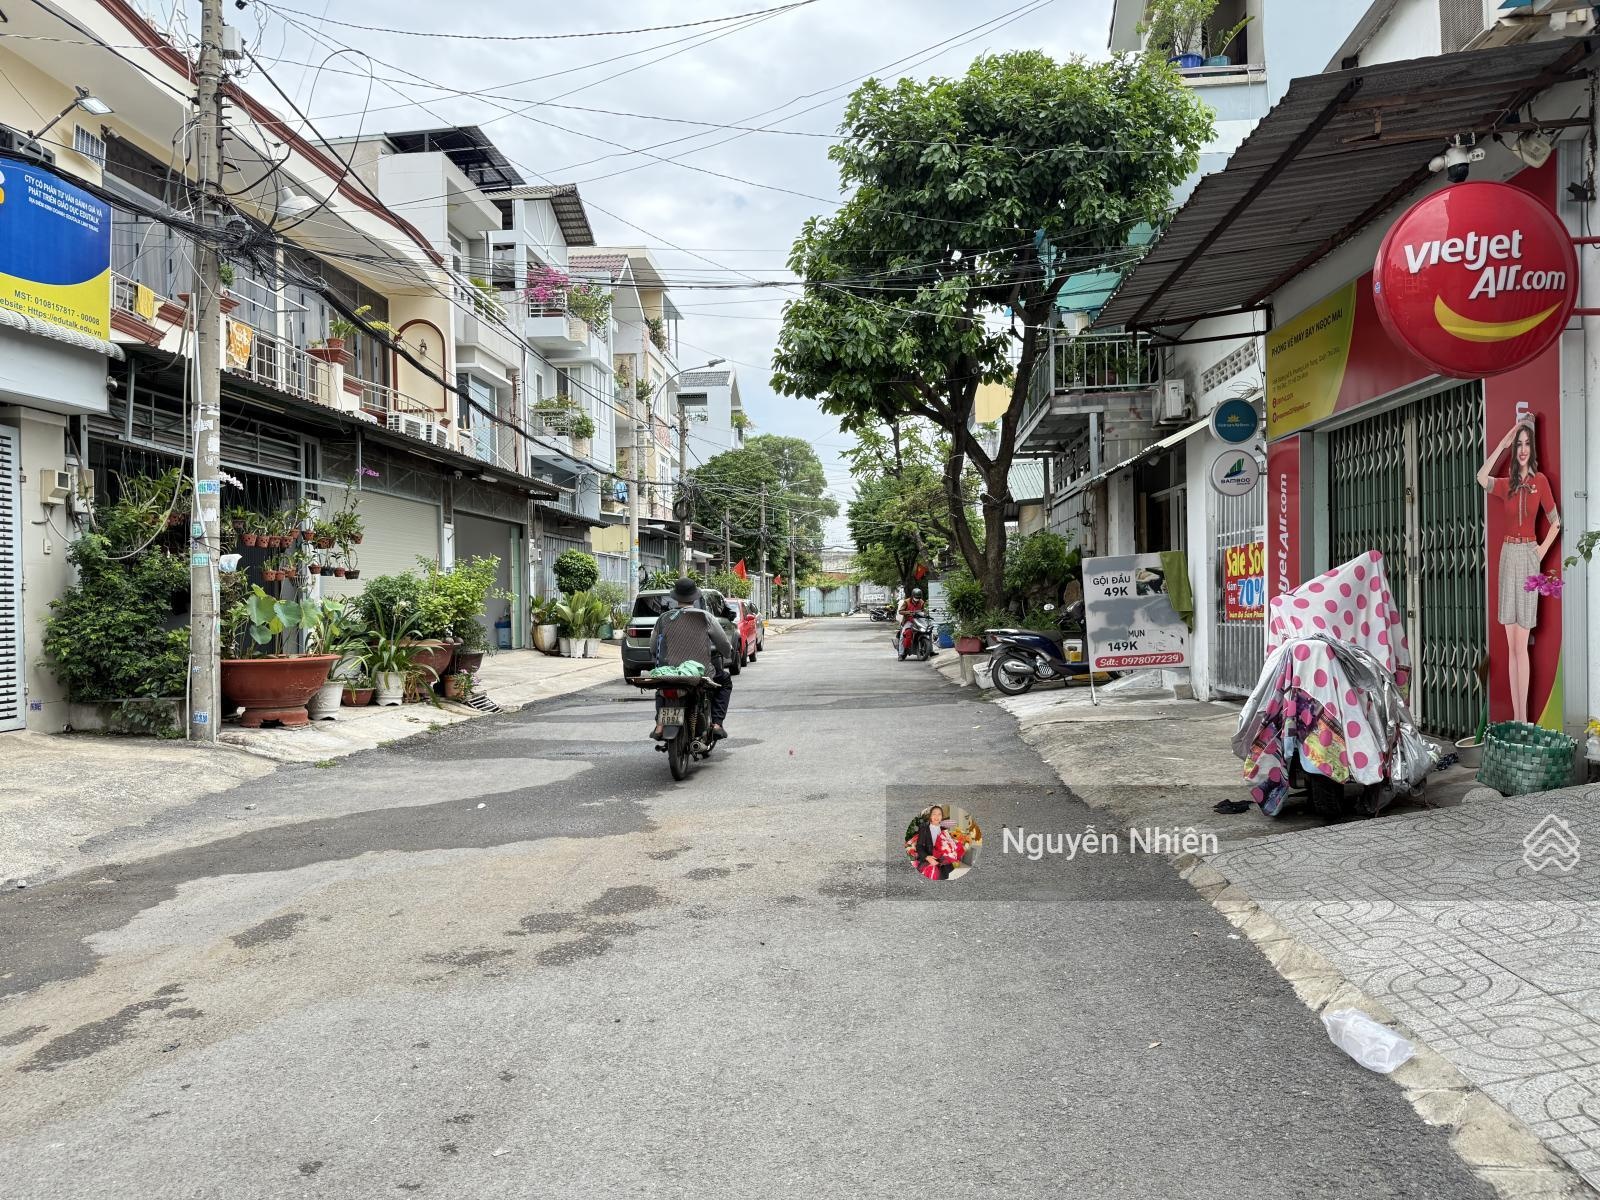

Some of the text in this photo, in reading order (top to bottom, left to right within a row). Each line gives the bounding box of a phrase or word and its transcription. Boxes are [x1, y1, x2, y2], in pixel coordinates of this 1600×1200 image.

[24, 174, 35, 185] CTY
[0, 297, 26, 312] ebsite:
[14, 289, 33, 303] MST:
[34, 296, 76, 317] 0108157817
[80, 312, 100, 326] 00008
[1226, 546, 1246, 577] Sale
[1093, 573, 1131, 587] GỘI ĐẦU
[1104, 586, 1128, 596] 49K
[1237, 578, 1264, 605] 70%
[1108, 641, 1138, 652] 149K
[1121, 654, 1180, 665] 0978077239
